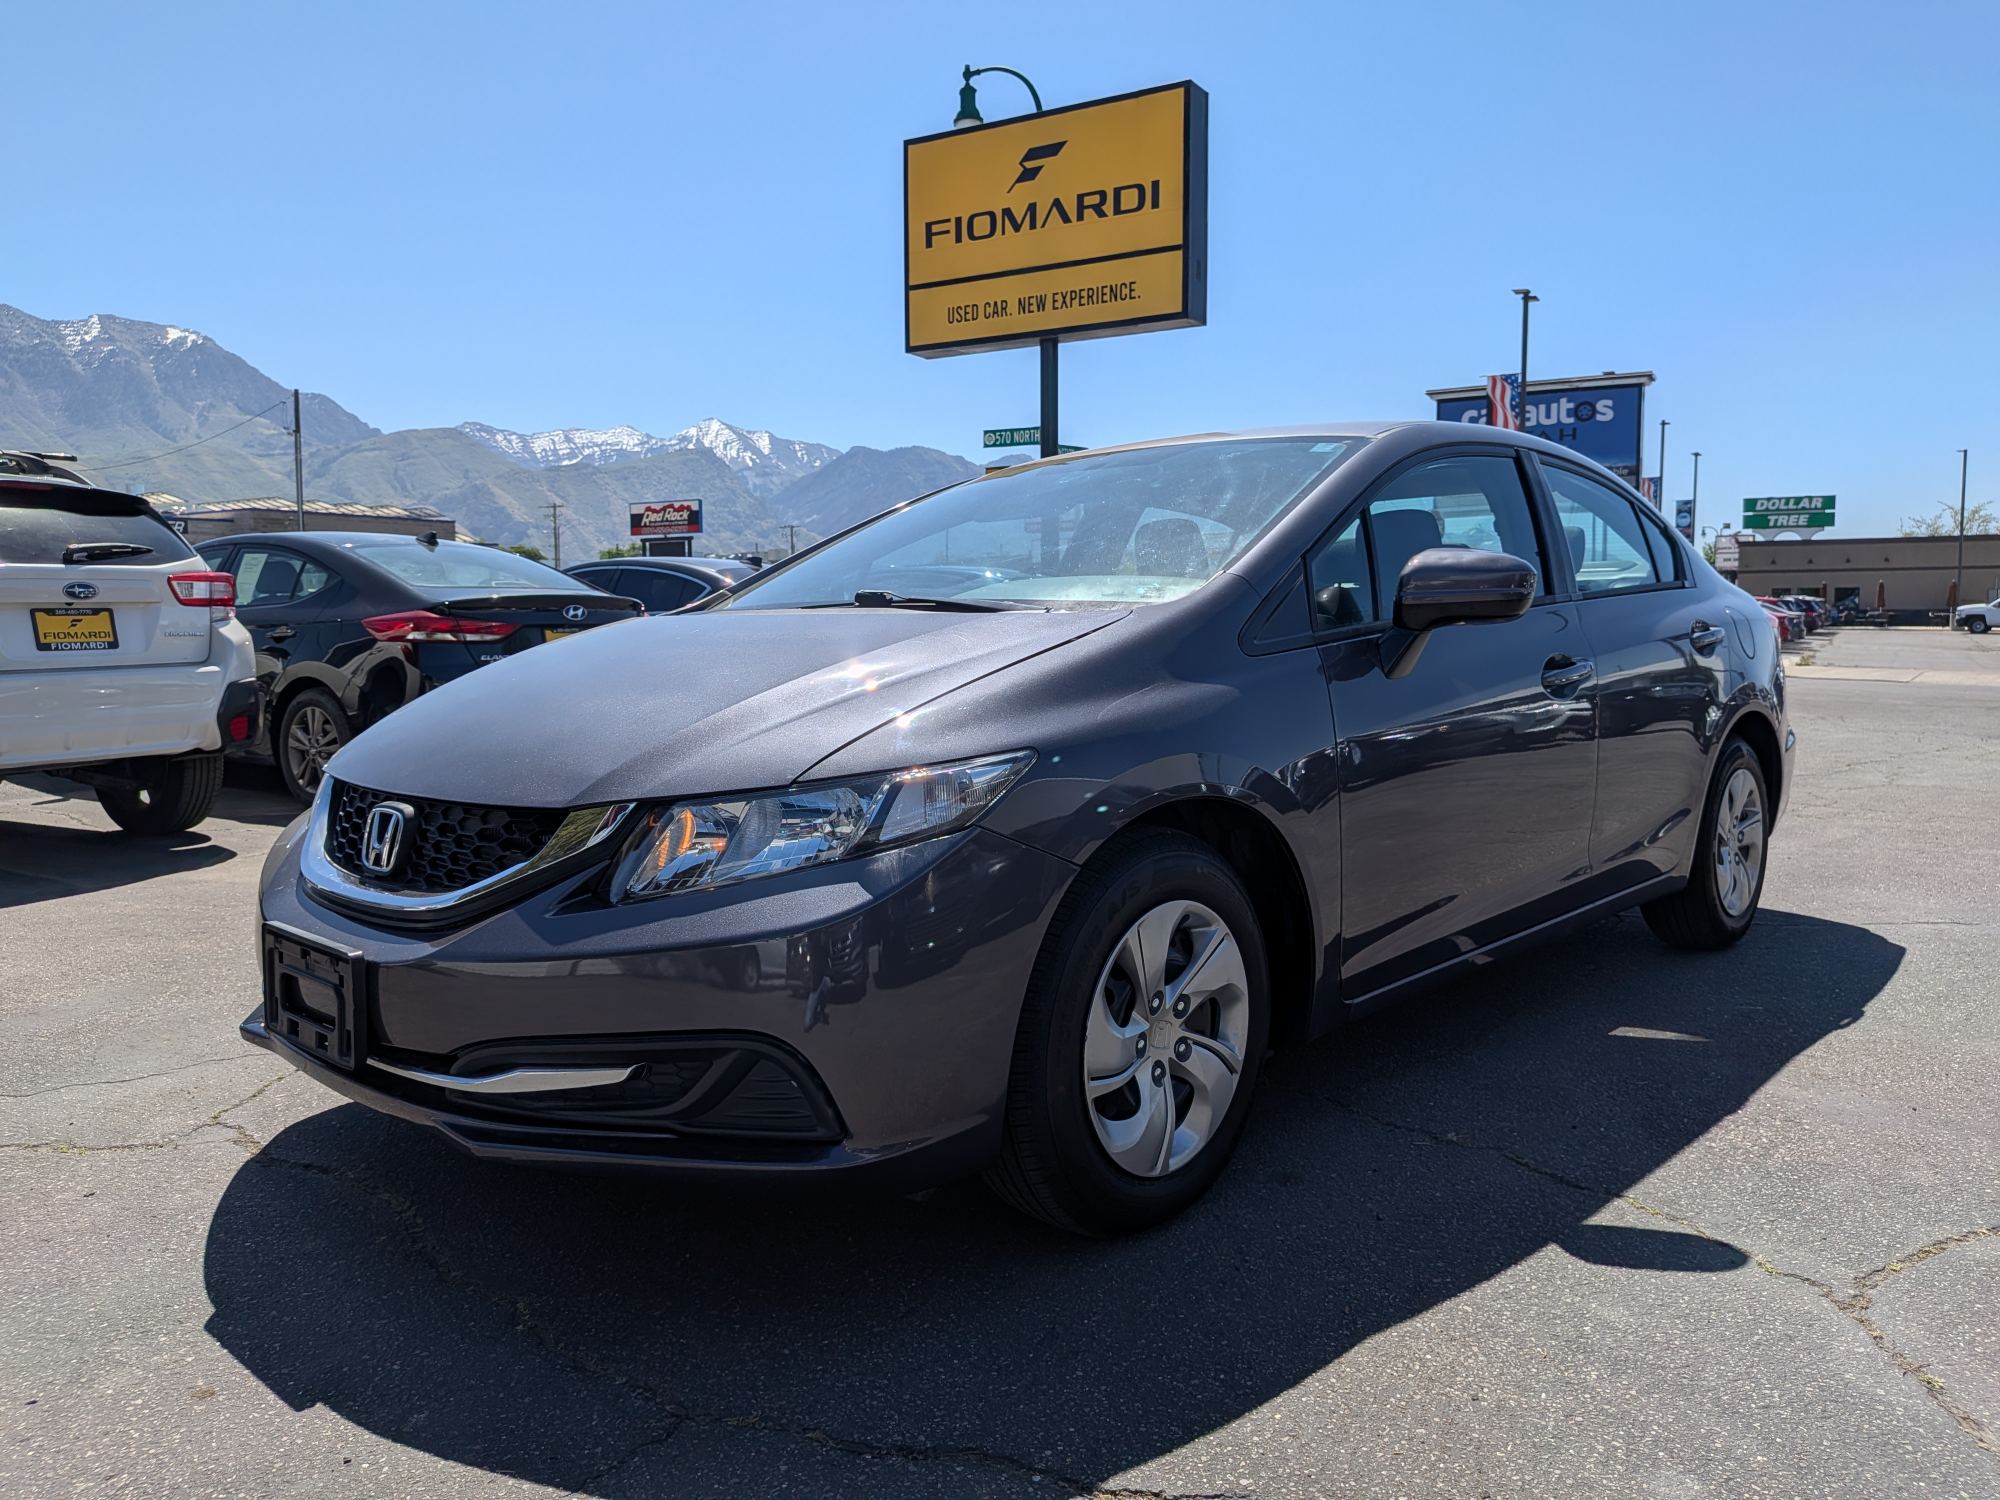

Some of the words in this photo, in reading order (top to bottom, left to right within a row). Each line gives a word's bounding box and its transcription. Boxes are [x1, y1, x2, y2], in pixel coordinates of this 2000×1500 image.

[925, 179, 1160, 249] FIOMARDI
[947, 304, 979, 324] USED
[983, 300, 1013, 319] CAR.
[1017, 293, 1048, 316] NEW
[1052, 281, 1141, 311] EXPERIENCE.
[995, 431, 1011, 445] 570
[1013, 429, 1041, 443] NORTH
[1755, 497, 1823, 511] DOLLAR
[641, 510, 664, 526] Red
[663, 508, 690, 521] Rock
[1767, 514, 1810, 527] TREE
[43, 631, 111, 640] FIOMARDI
[51, 641, 109, 650] FIOMARDI
